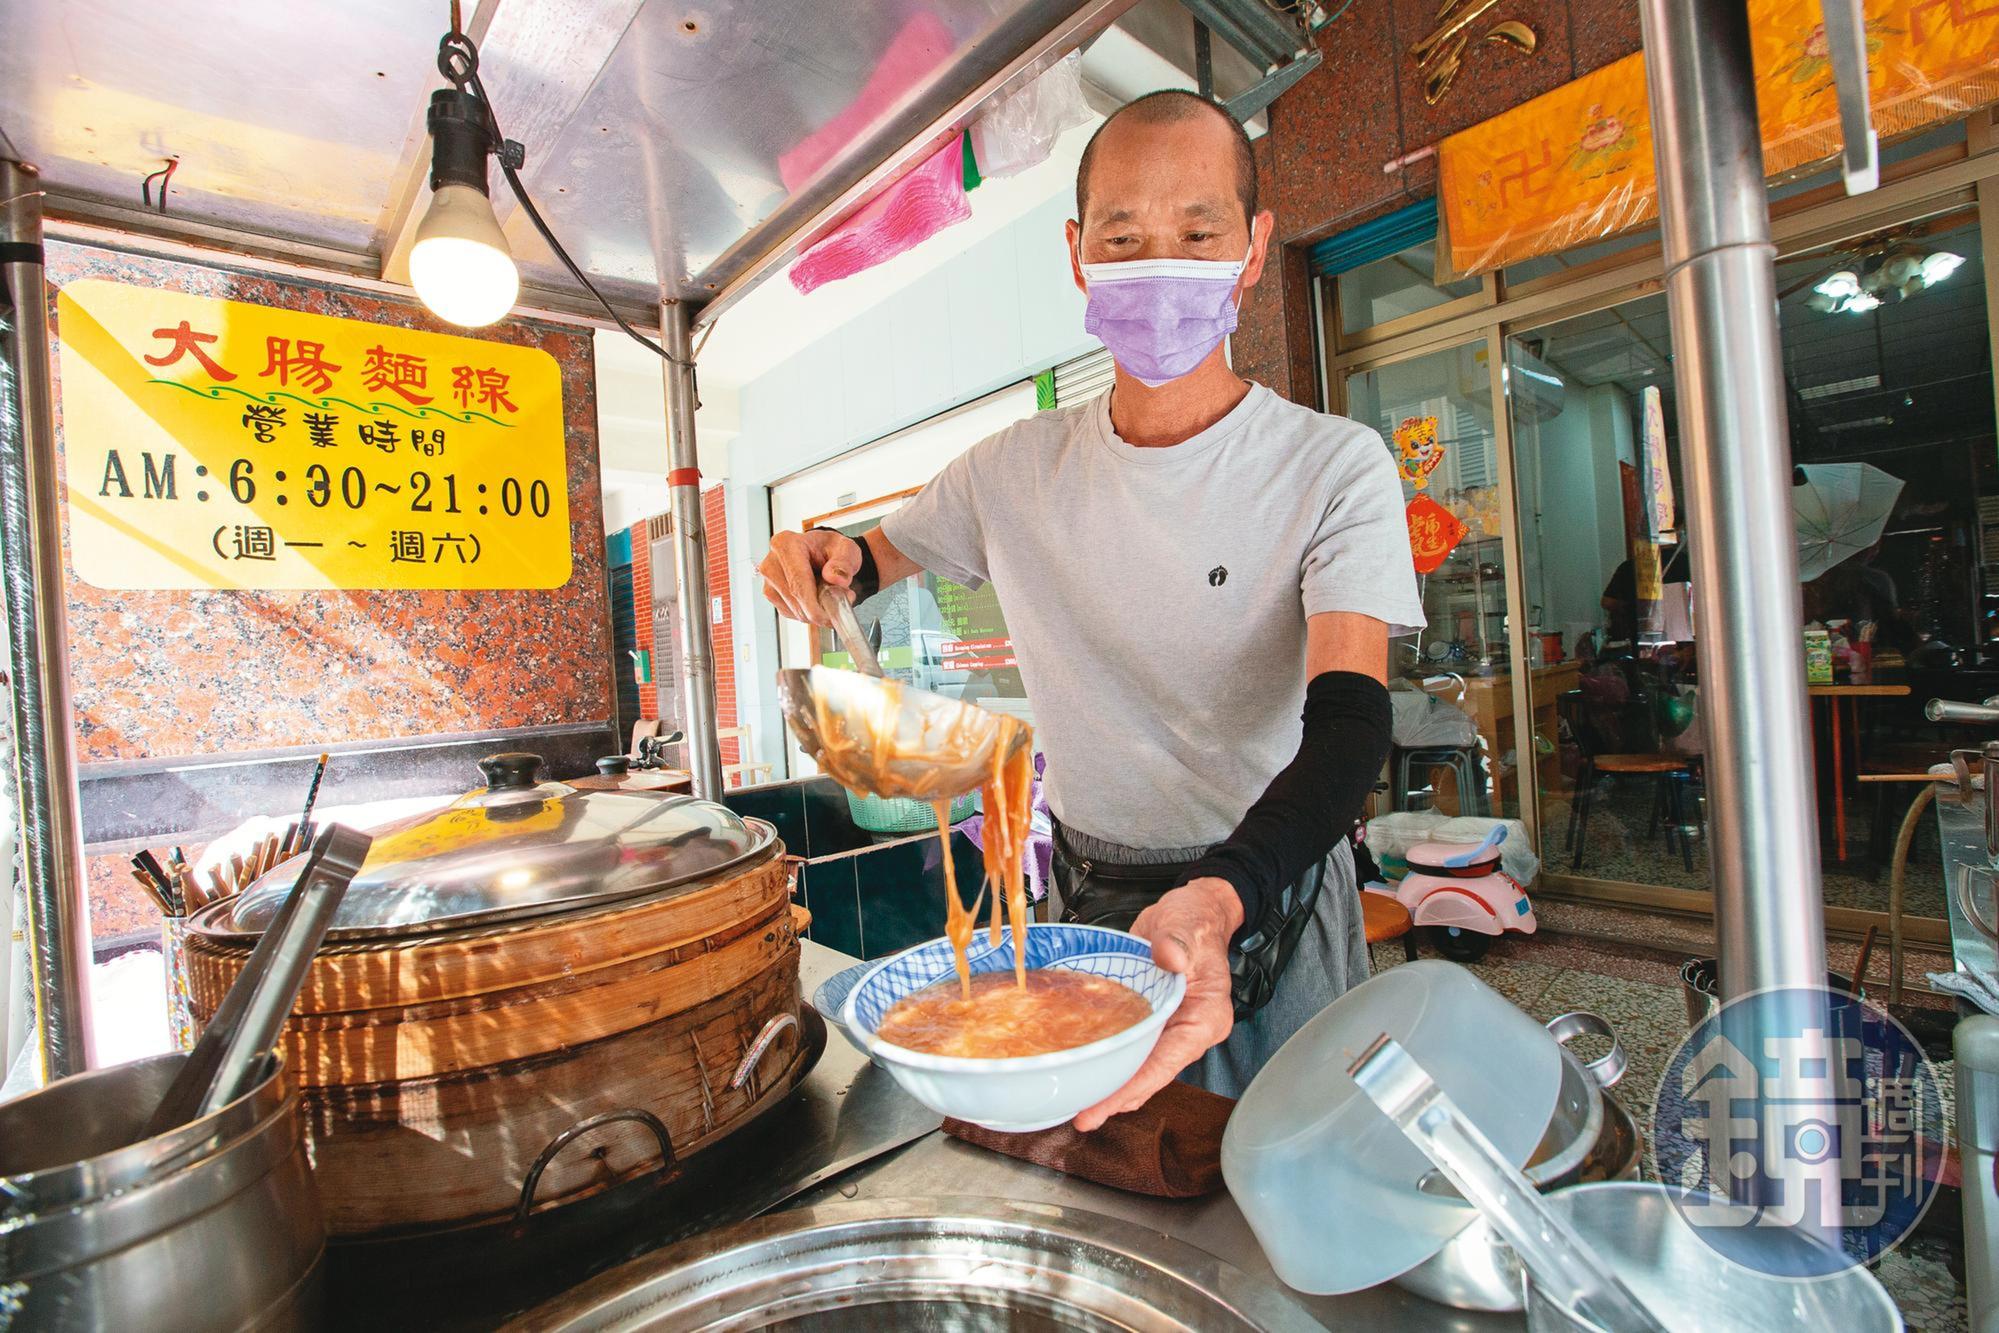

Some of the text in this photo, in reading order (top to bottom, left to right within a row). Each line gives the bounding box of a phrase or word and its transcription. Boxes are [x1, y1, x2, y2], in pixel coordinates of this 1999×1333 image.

[144, 320, 519, 414] 大腸麵線
[242, 403, 446, 457] 營業時間
